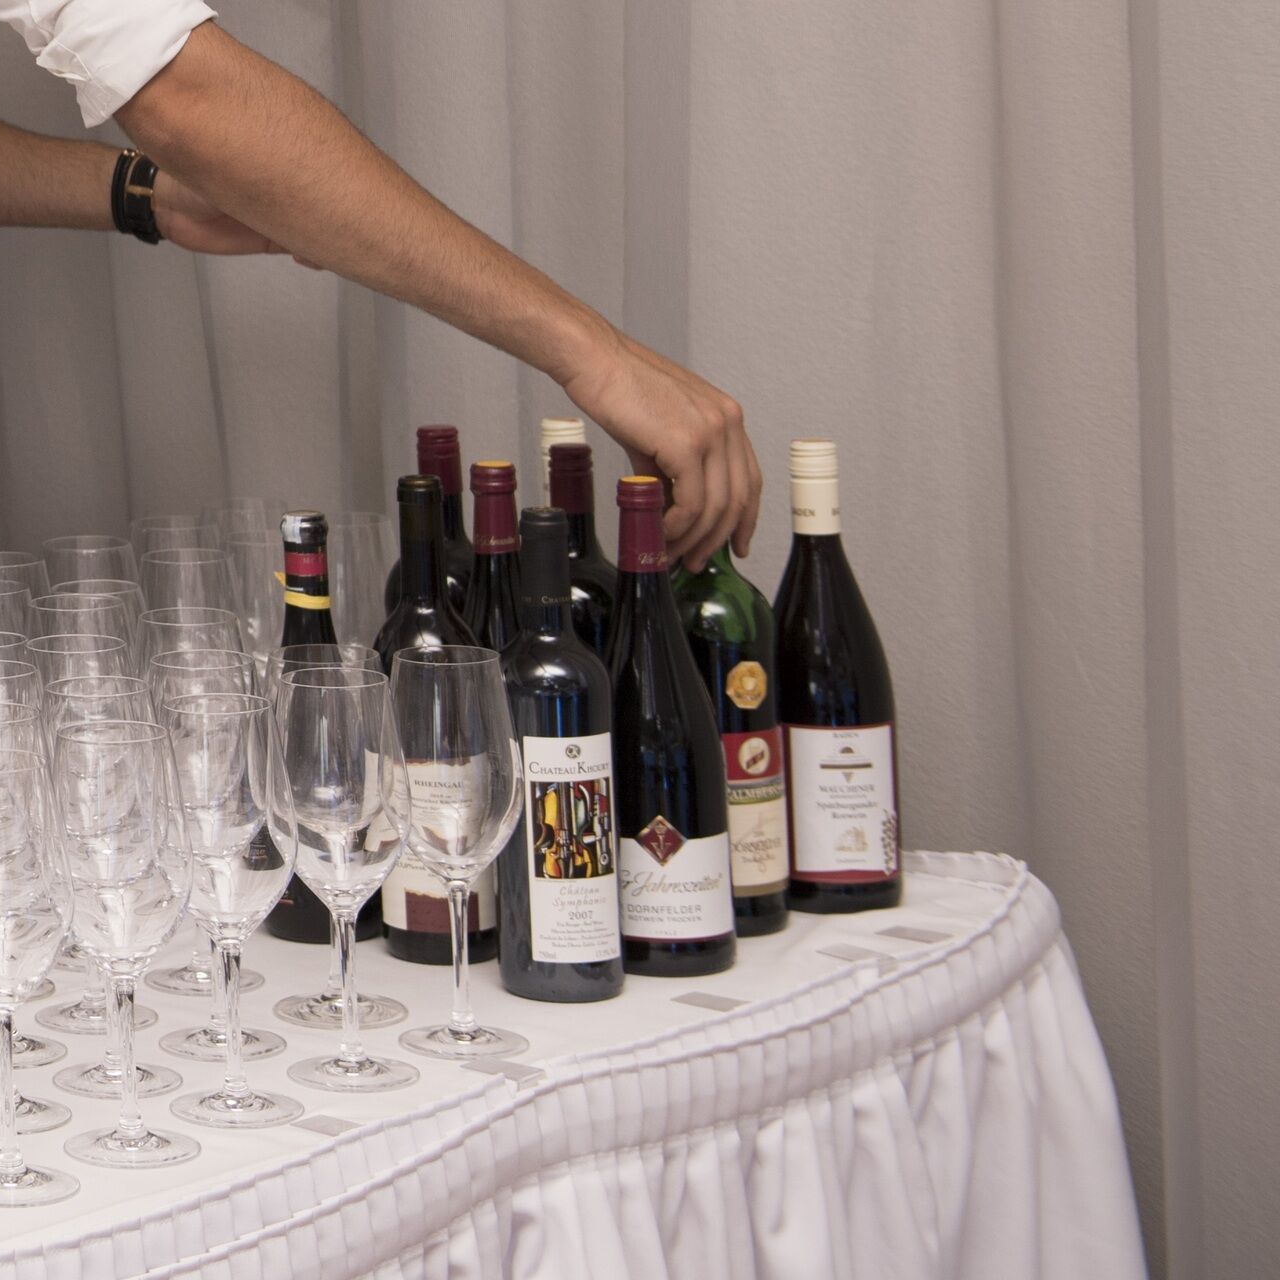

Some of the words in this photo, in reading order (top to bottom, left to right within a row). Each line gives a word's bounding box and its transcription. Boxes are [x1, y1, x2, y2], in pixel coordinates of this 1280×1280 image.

[529, 761, 576, 775] CHATEAU
[568, 910, 593, 920] 2007
[627, 904, 702, 915] DORNFELDER
